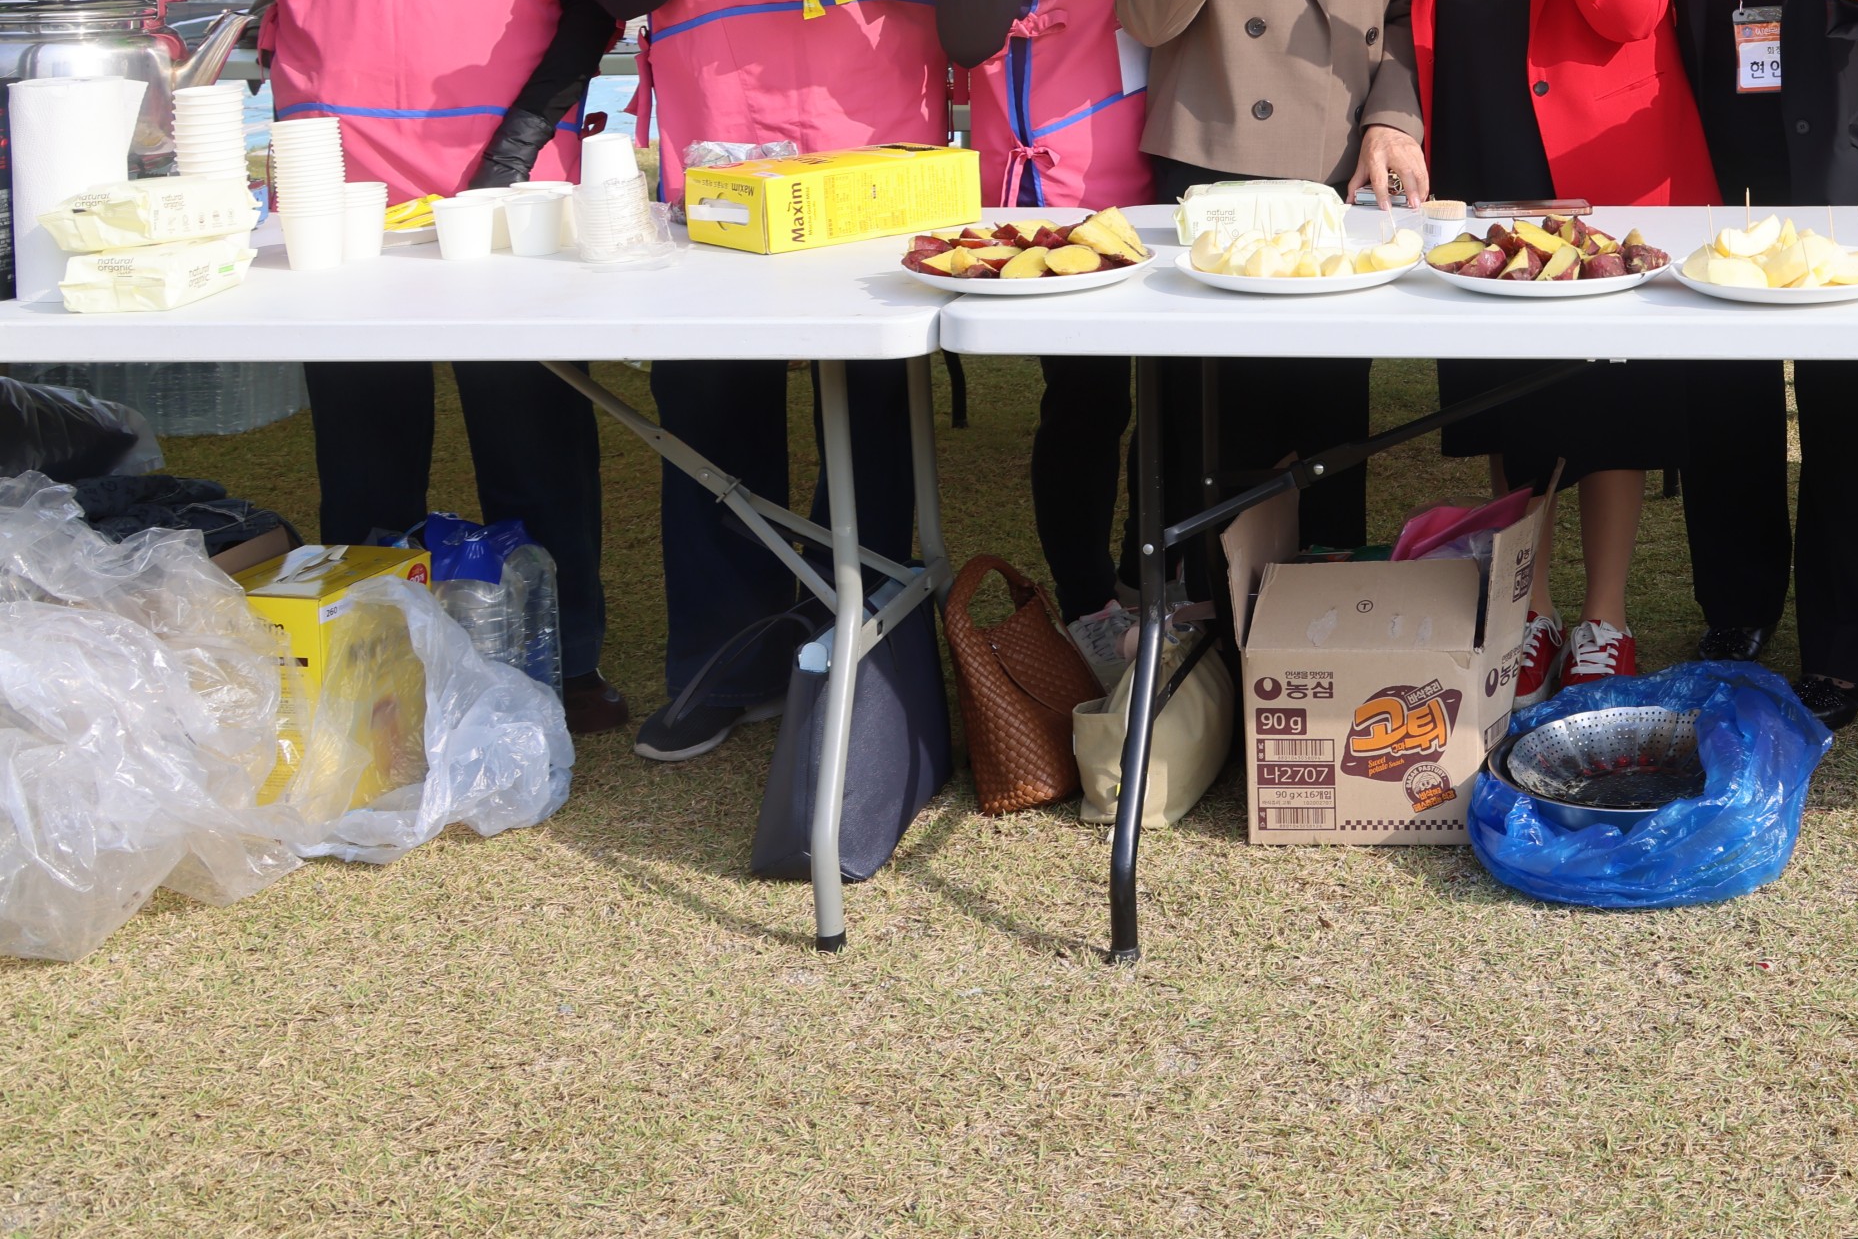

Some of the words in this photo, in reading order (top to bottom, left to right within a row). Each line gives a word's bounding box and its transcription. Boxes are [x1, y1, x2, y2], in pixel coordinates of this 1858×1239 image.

[731, 182, 754, 196] Maxim
[788, 182, 805, 242] Maxim
[97, 264, 134, 273] organic
[326, 606, 338, 618] 260
[1285, 671, 1308, 679] 인생을
[1309, 671, 1334, 679] 맛있게
[1285, 680, 1334, 700] 농심
[1407, 681, 1440, 704] 바삭츄리
[1260, 712, 1286, 730] 90
[1289, 716, 1302, 733] g
[1351, 698, 1447, 752] 고튀
[1368, 756, 1386, 768] Sweet
[1263, 766, 1329, 784] 나2707
[1368, 763, 1388, 777] potato
[1417, 765, 1447, 778] PASTURY
[1275, 790, 1288, 799] 90
